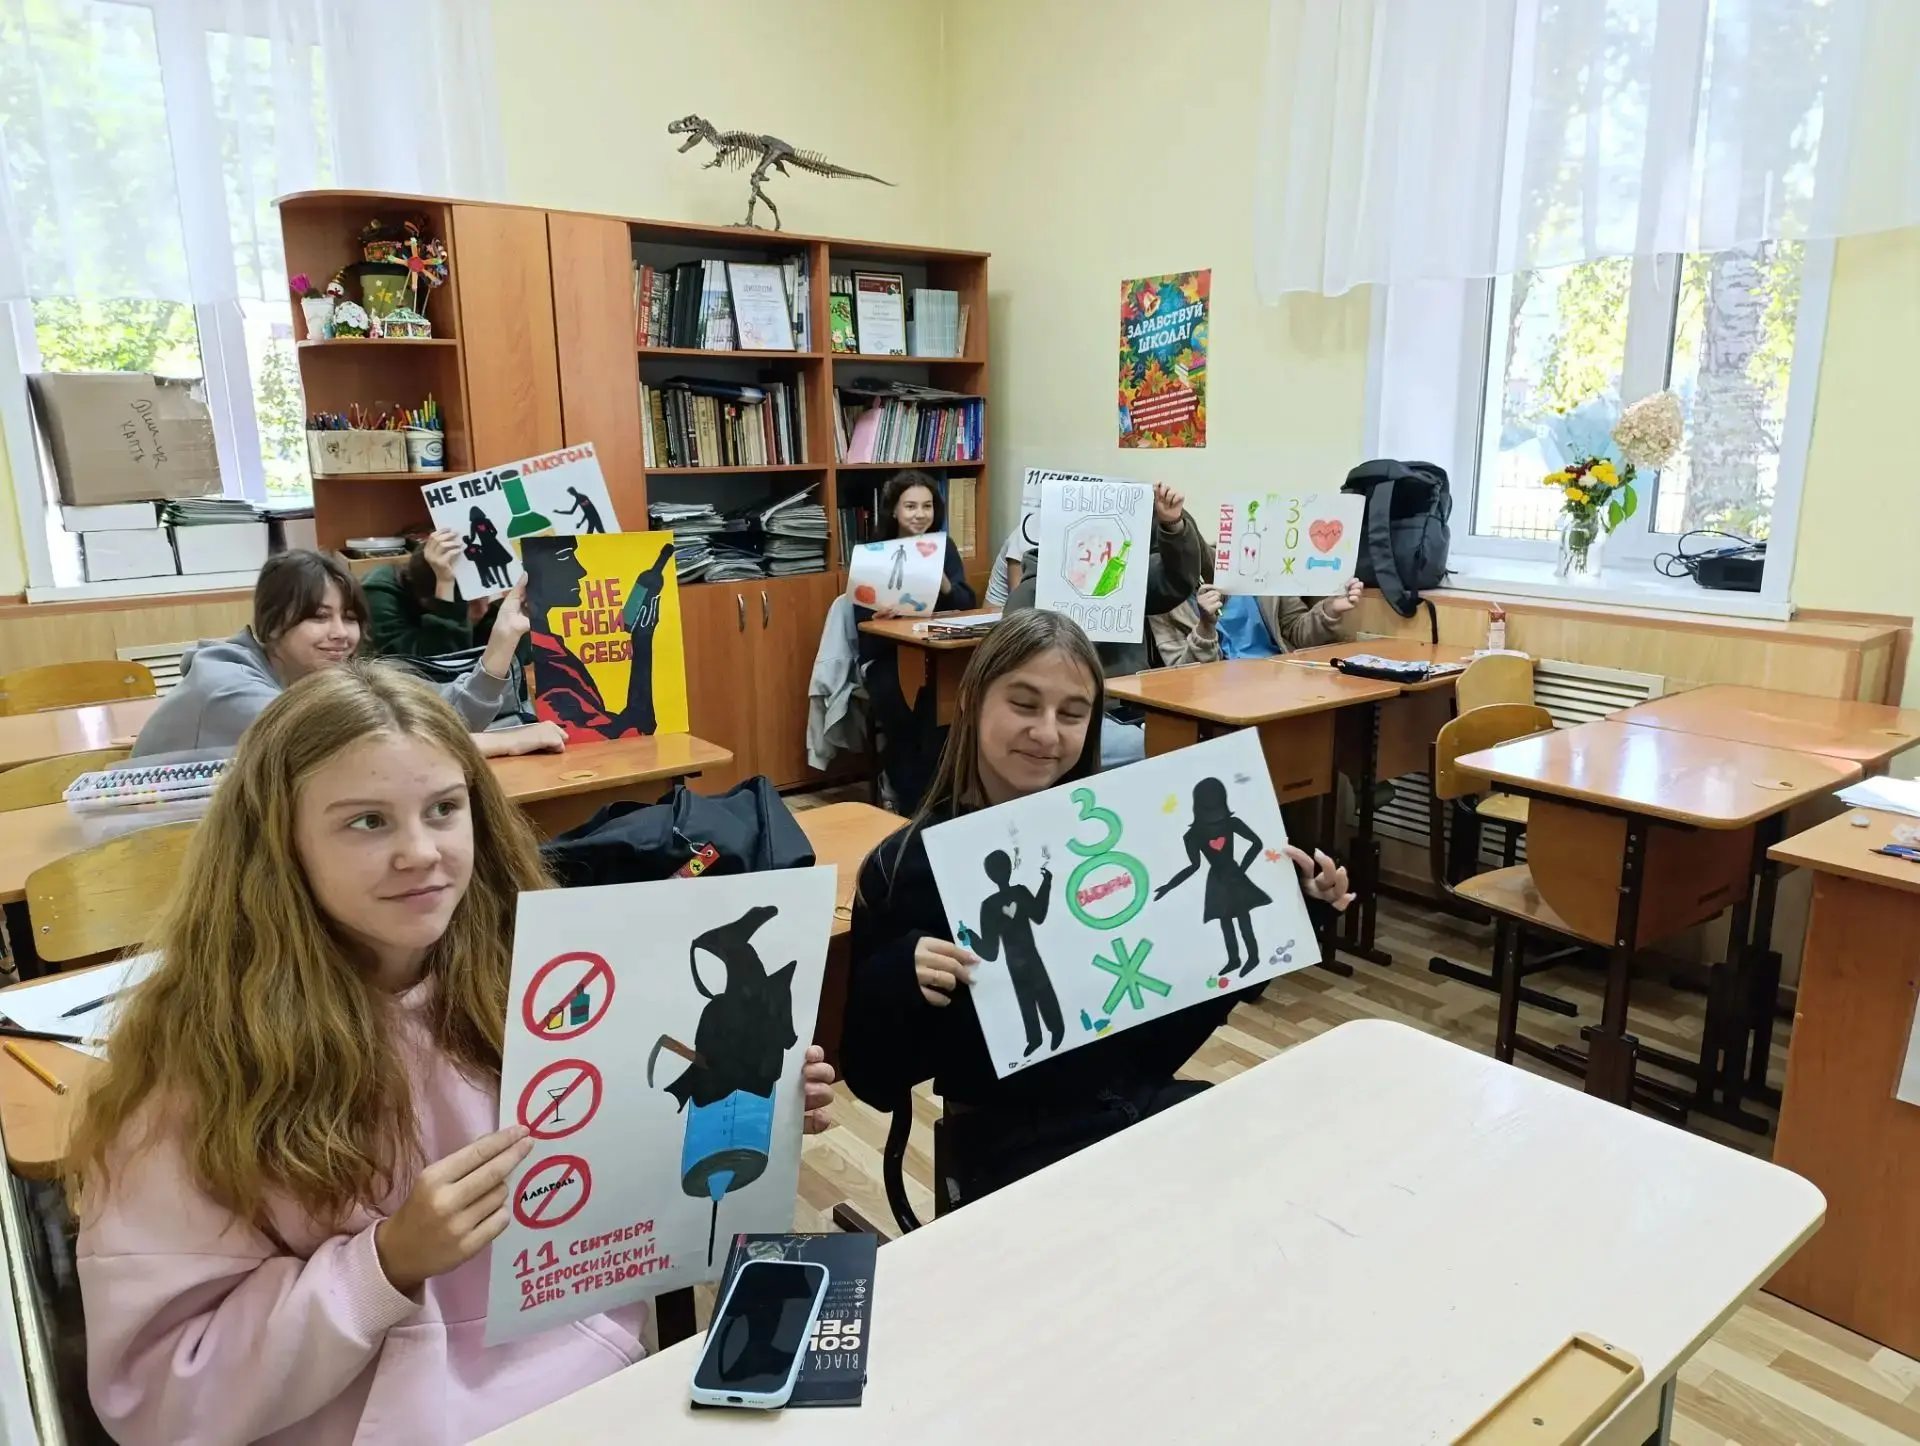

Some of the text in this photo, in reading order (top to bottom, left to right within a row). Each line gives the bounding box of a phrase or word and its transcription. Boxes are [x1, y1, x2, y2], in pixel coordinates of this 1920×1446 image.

[1138, 322, 1192, 353] ШКОЛА!
[424, 446, 593, 508] НЕ ПЕЙ АЛКОГОЛЬ
[1061, 484, 1144, 517] ВЫБОР
[1215, 550, 1230, 571] НЕ
[585, 578, 623, 609] НЕ
[562, 609, 625, 638] ГУБИ
[580, 640, 634, 665] СЕБЯ
[512, 1219, 655, 1279] 11 СЕНТЯБРЯ
[520, 1237, 657, 1296] ВСЕРОССИЙСКИЙ
[519, 1287, 565, 1312] ДЕНЬ
[809, 1335, 861, 1352] COL
[814, 1353, 859, 1370] BLACK
